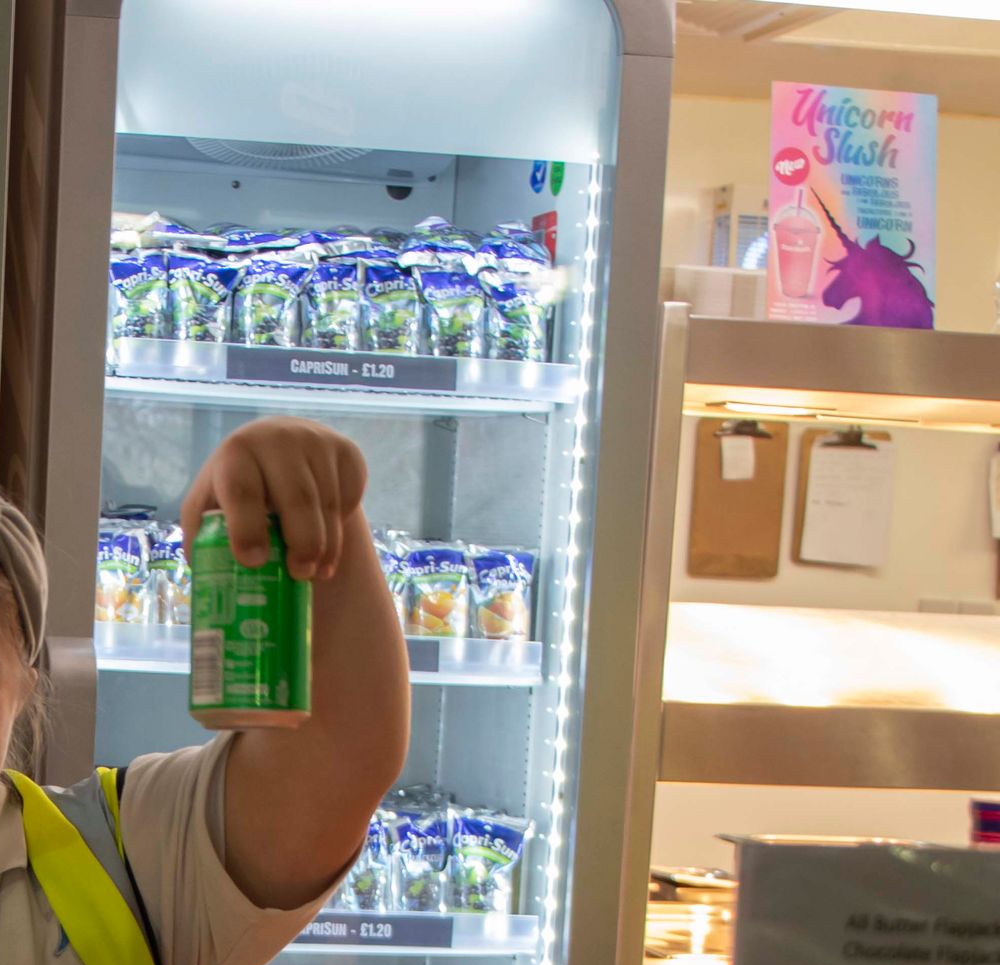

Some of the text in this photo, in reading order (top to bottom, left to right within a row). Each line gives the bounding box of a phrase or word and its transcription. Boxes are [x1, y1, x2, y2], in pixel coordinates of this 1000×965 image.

[791, 88, 915, 138] Unicorn
[812, 127, 900, 169] Slush
[840, 173, 899, 190] UNICORNS
[856, 215, 913, 233] UNICORN
[361, 361, 395, 379] £1.20
[360, 922, 393, 938] £1.20
